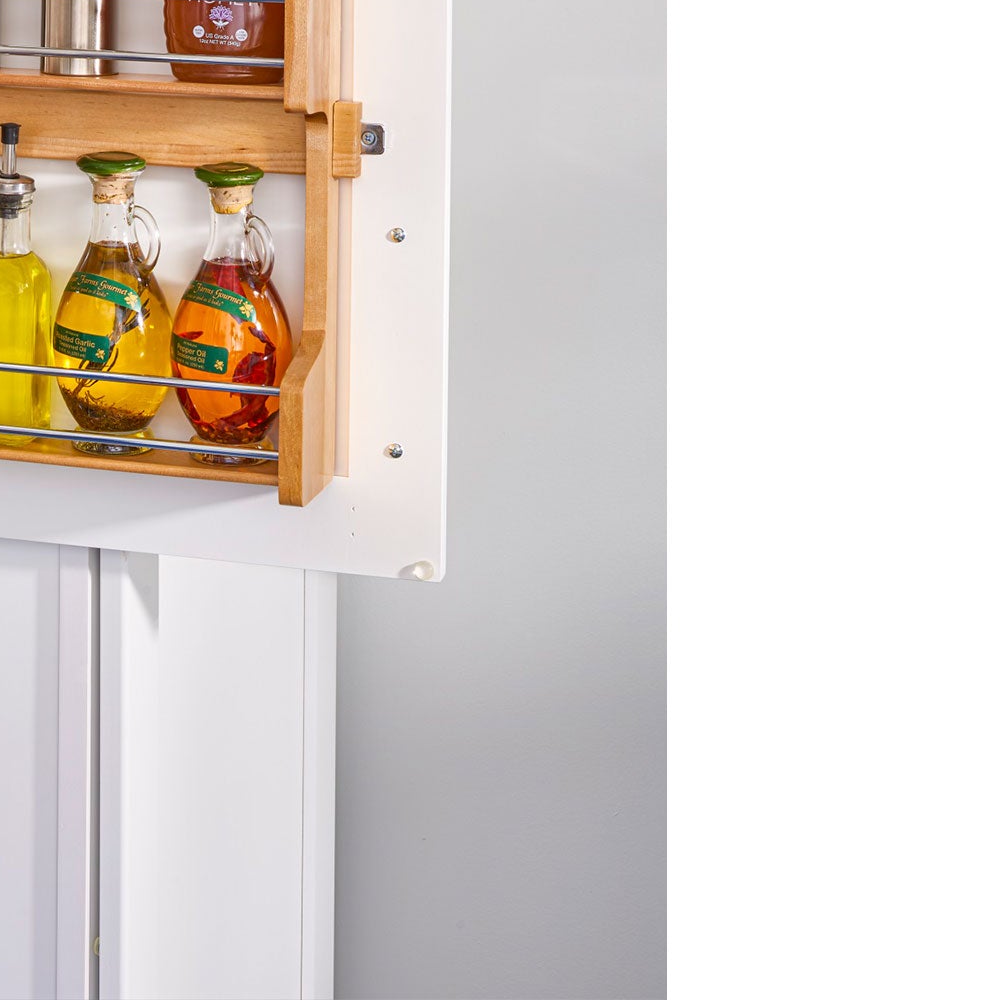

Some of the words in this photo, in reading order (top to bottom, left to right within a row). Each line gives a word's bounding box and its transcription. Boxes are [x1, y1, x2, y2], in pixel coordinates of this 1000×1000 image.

[98, 280, 128, 296] Gourmet
[212, 288, 243, 304] Gourmet
[74, 338, 96, 348] Garlic
[196, 350, 207, 358] Oil
